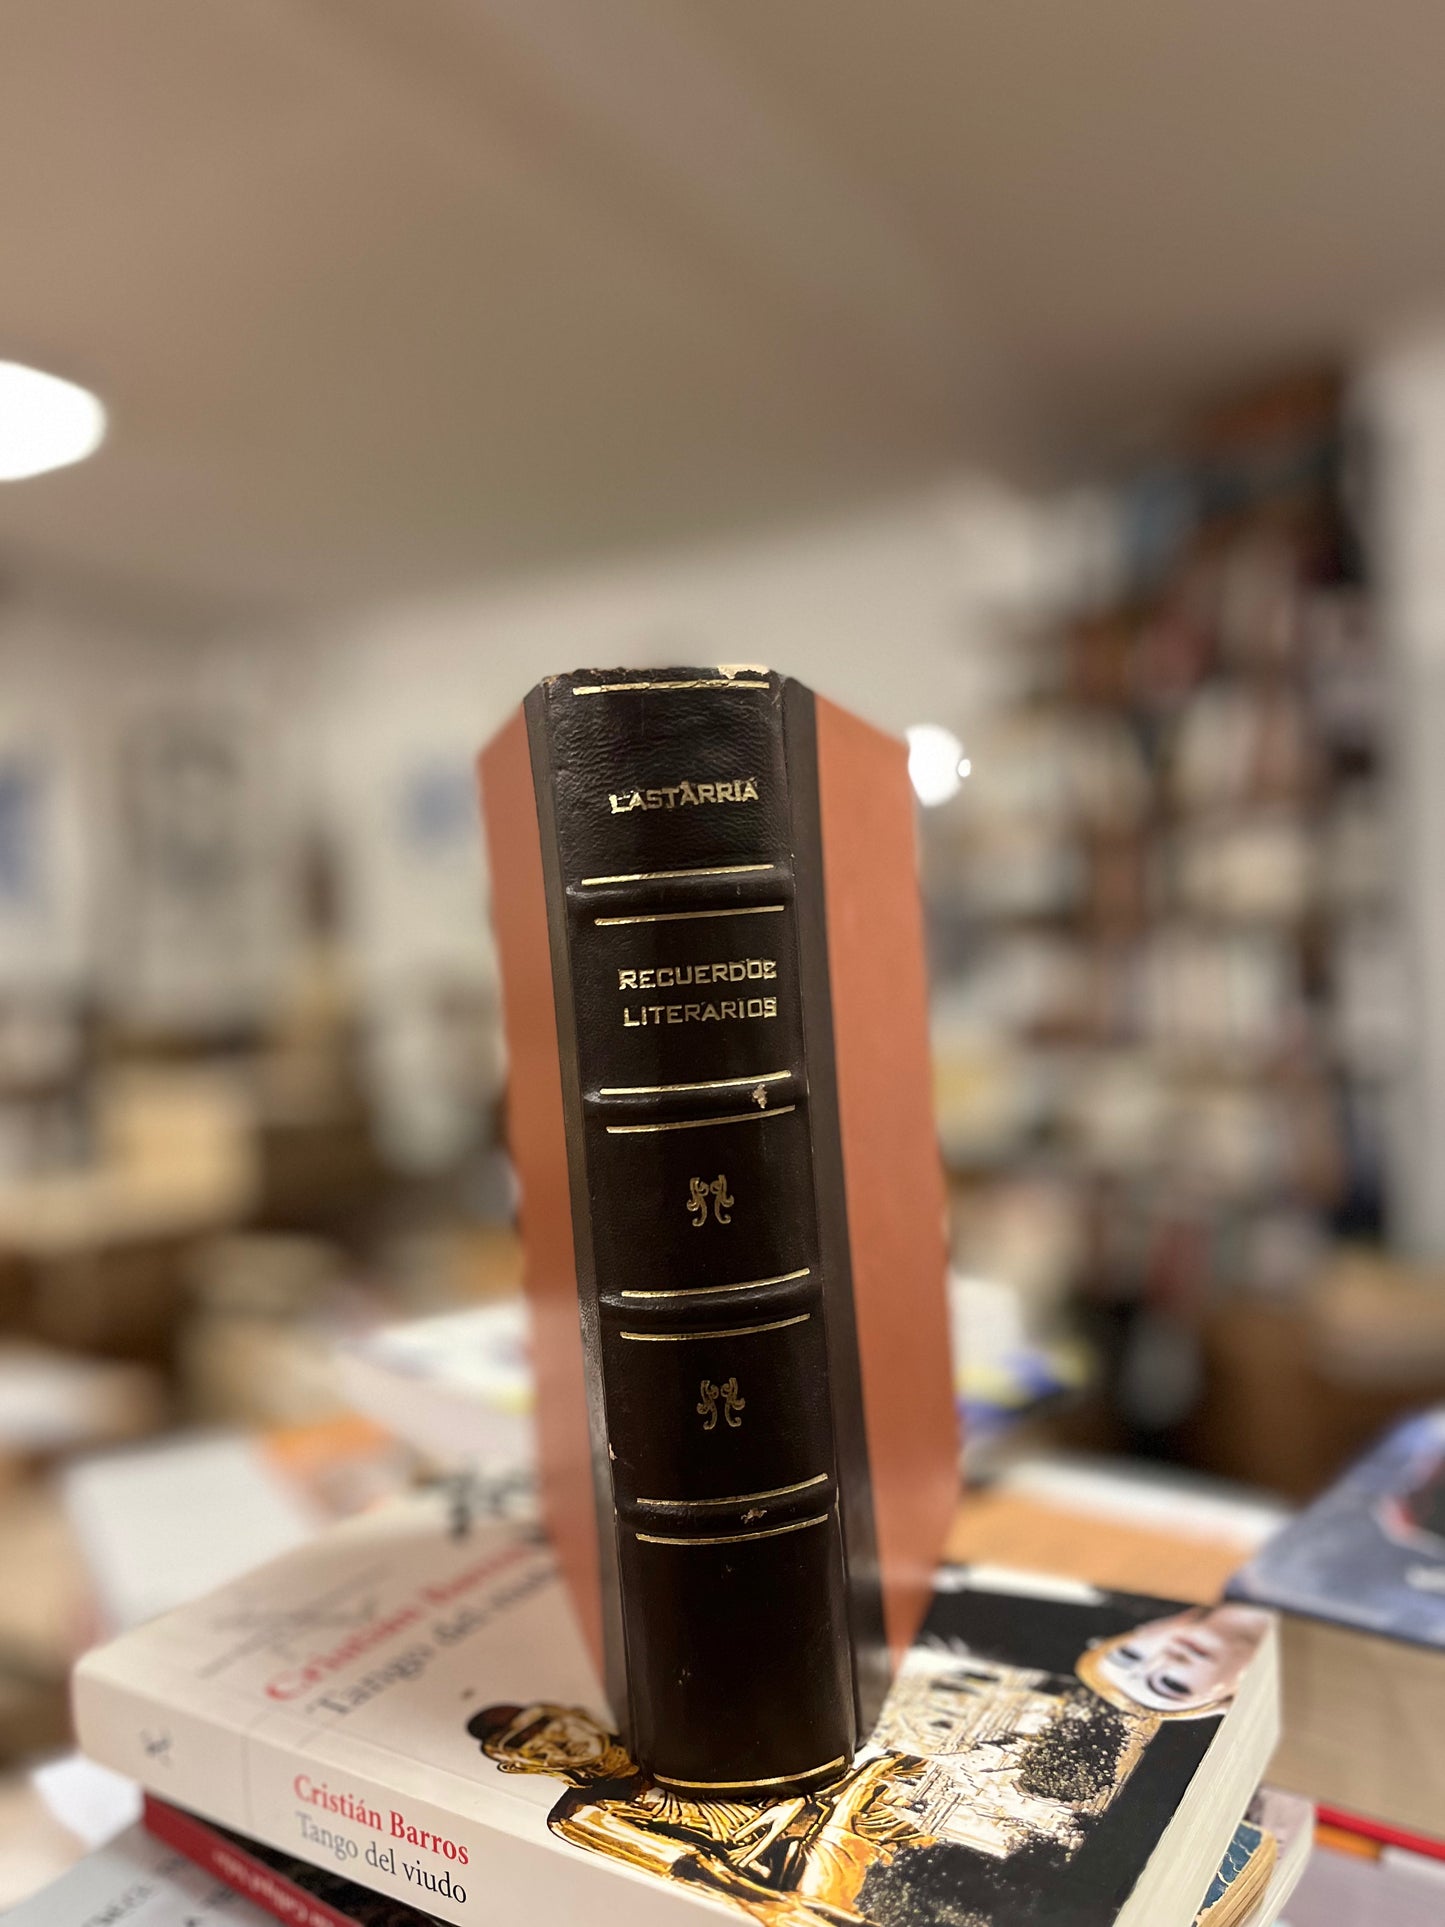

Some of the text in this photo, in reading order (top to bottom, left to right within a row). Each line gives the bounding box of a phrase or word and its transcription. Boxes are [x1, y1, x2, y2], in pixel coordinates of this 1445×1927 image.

[609, 777, 759, 814] LASTARRIA
[618, 959, 777, 990] RECUERDOS
[623, 997, 777, 1027] LITERARIOS
[293, 1774, 469, 1865] Cristián Barros
[295, 1811, 467, 1904] Tango del viudo
